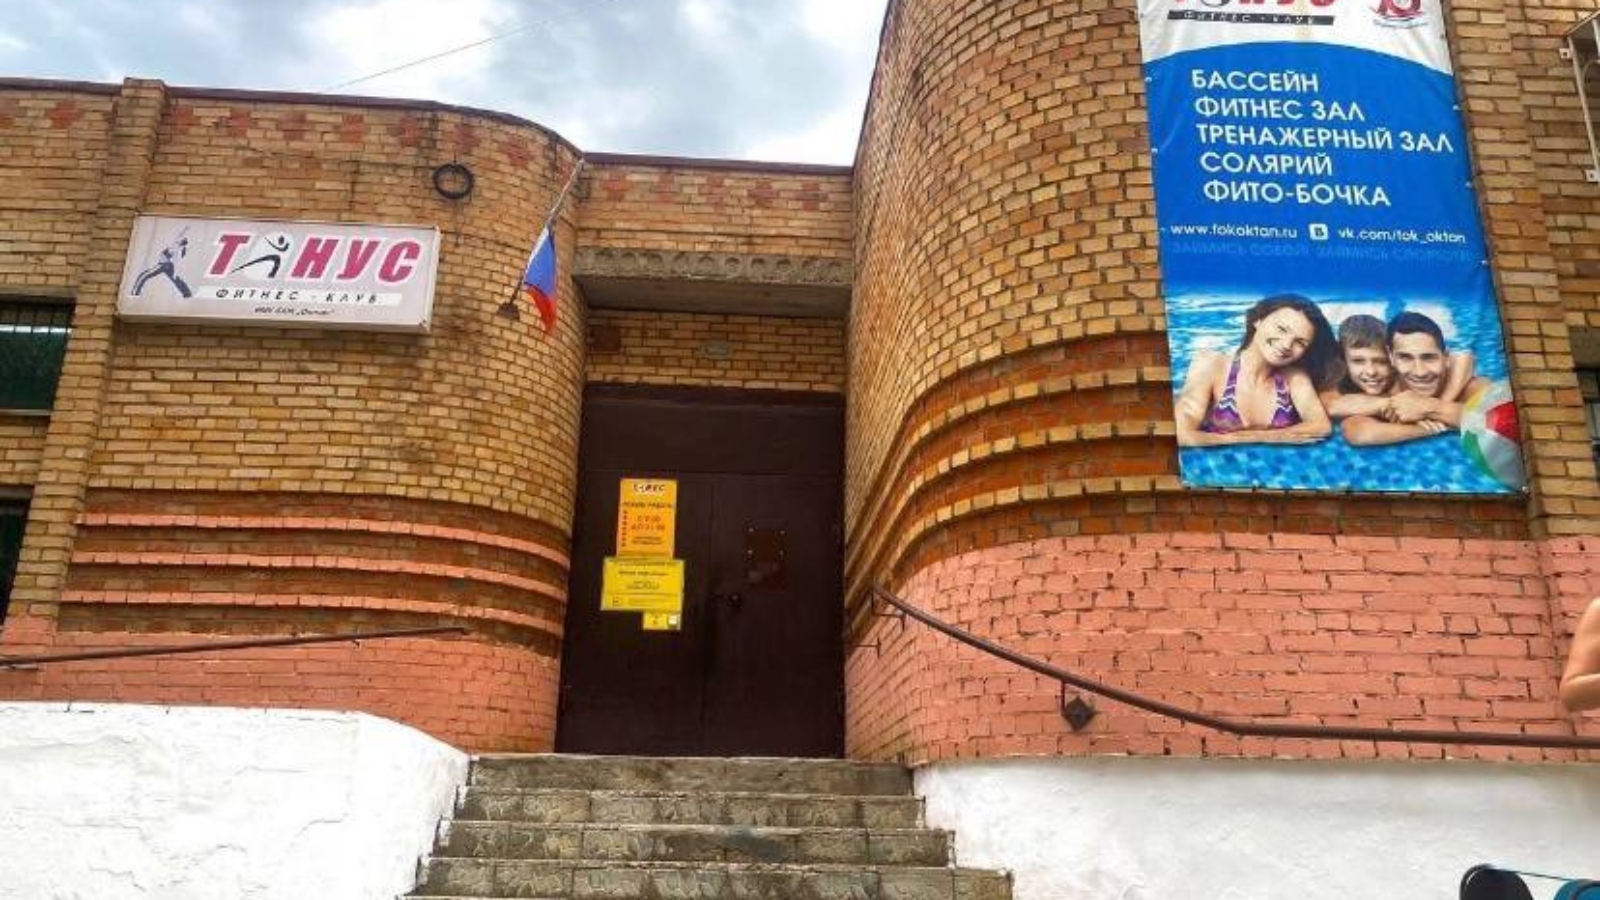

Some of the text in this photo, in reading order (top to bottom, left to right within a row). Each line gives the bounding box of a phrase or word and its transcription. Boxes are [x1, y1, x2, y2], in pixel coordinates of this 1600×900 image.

[1191, 69, 1319, 92] БАССЕЙН
[1195, 96, 1365, 122] ФИТНЕС ЗАЛ
[1195, 123, 1454, 153] ТРЕНАЖЕРНЫЙ ЗАЛ
[1200, 151, 1333, 176] СОЛЯРИЙ
[1203, 180, 1392, 207] ФИТО-БОЧКА
[1170, 223, 1298, 239] www.fokoktan.ru
[216, 289, 299, 300] ФИТНЕС
[326, 292, 377, 303] КЛУБ
